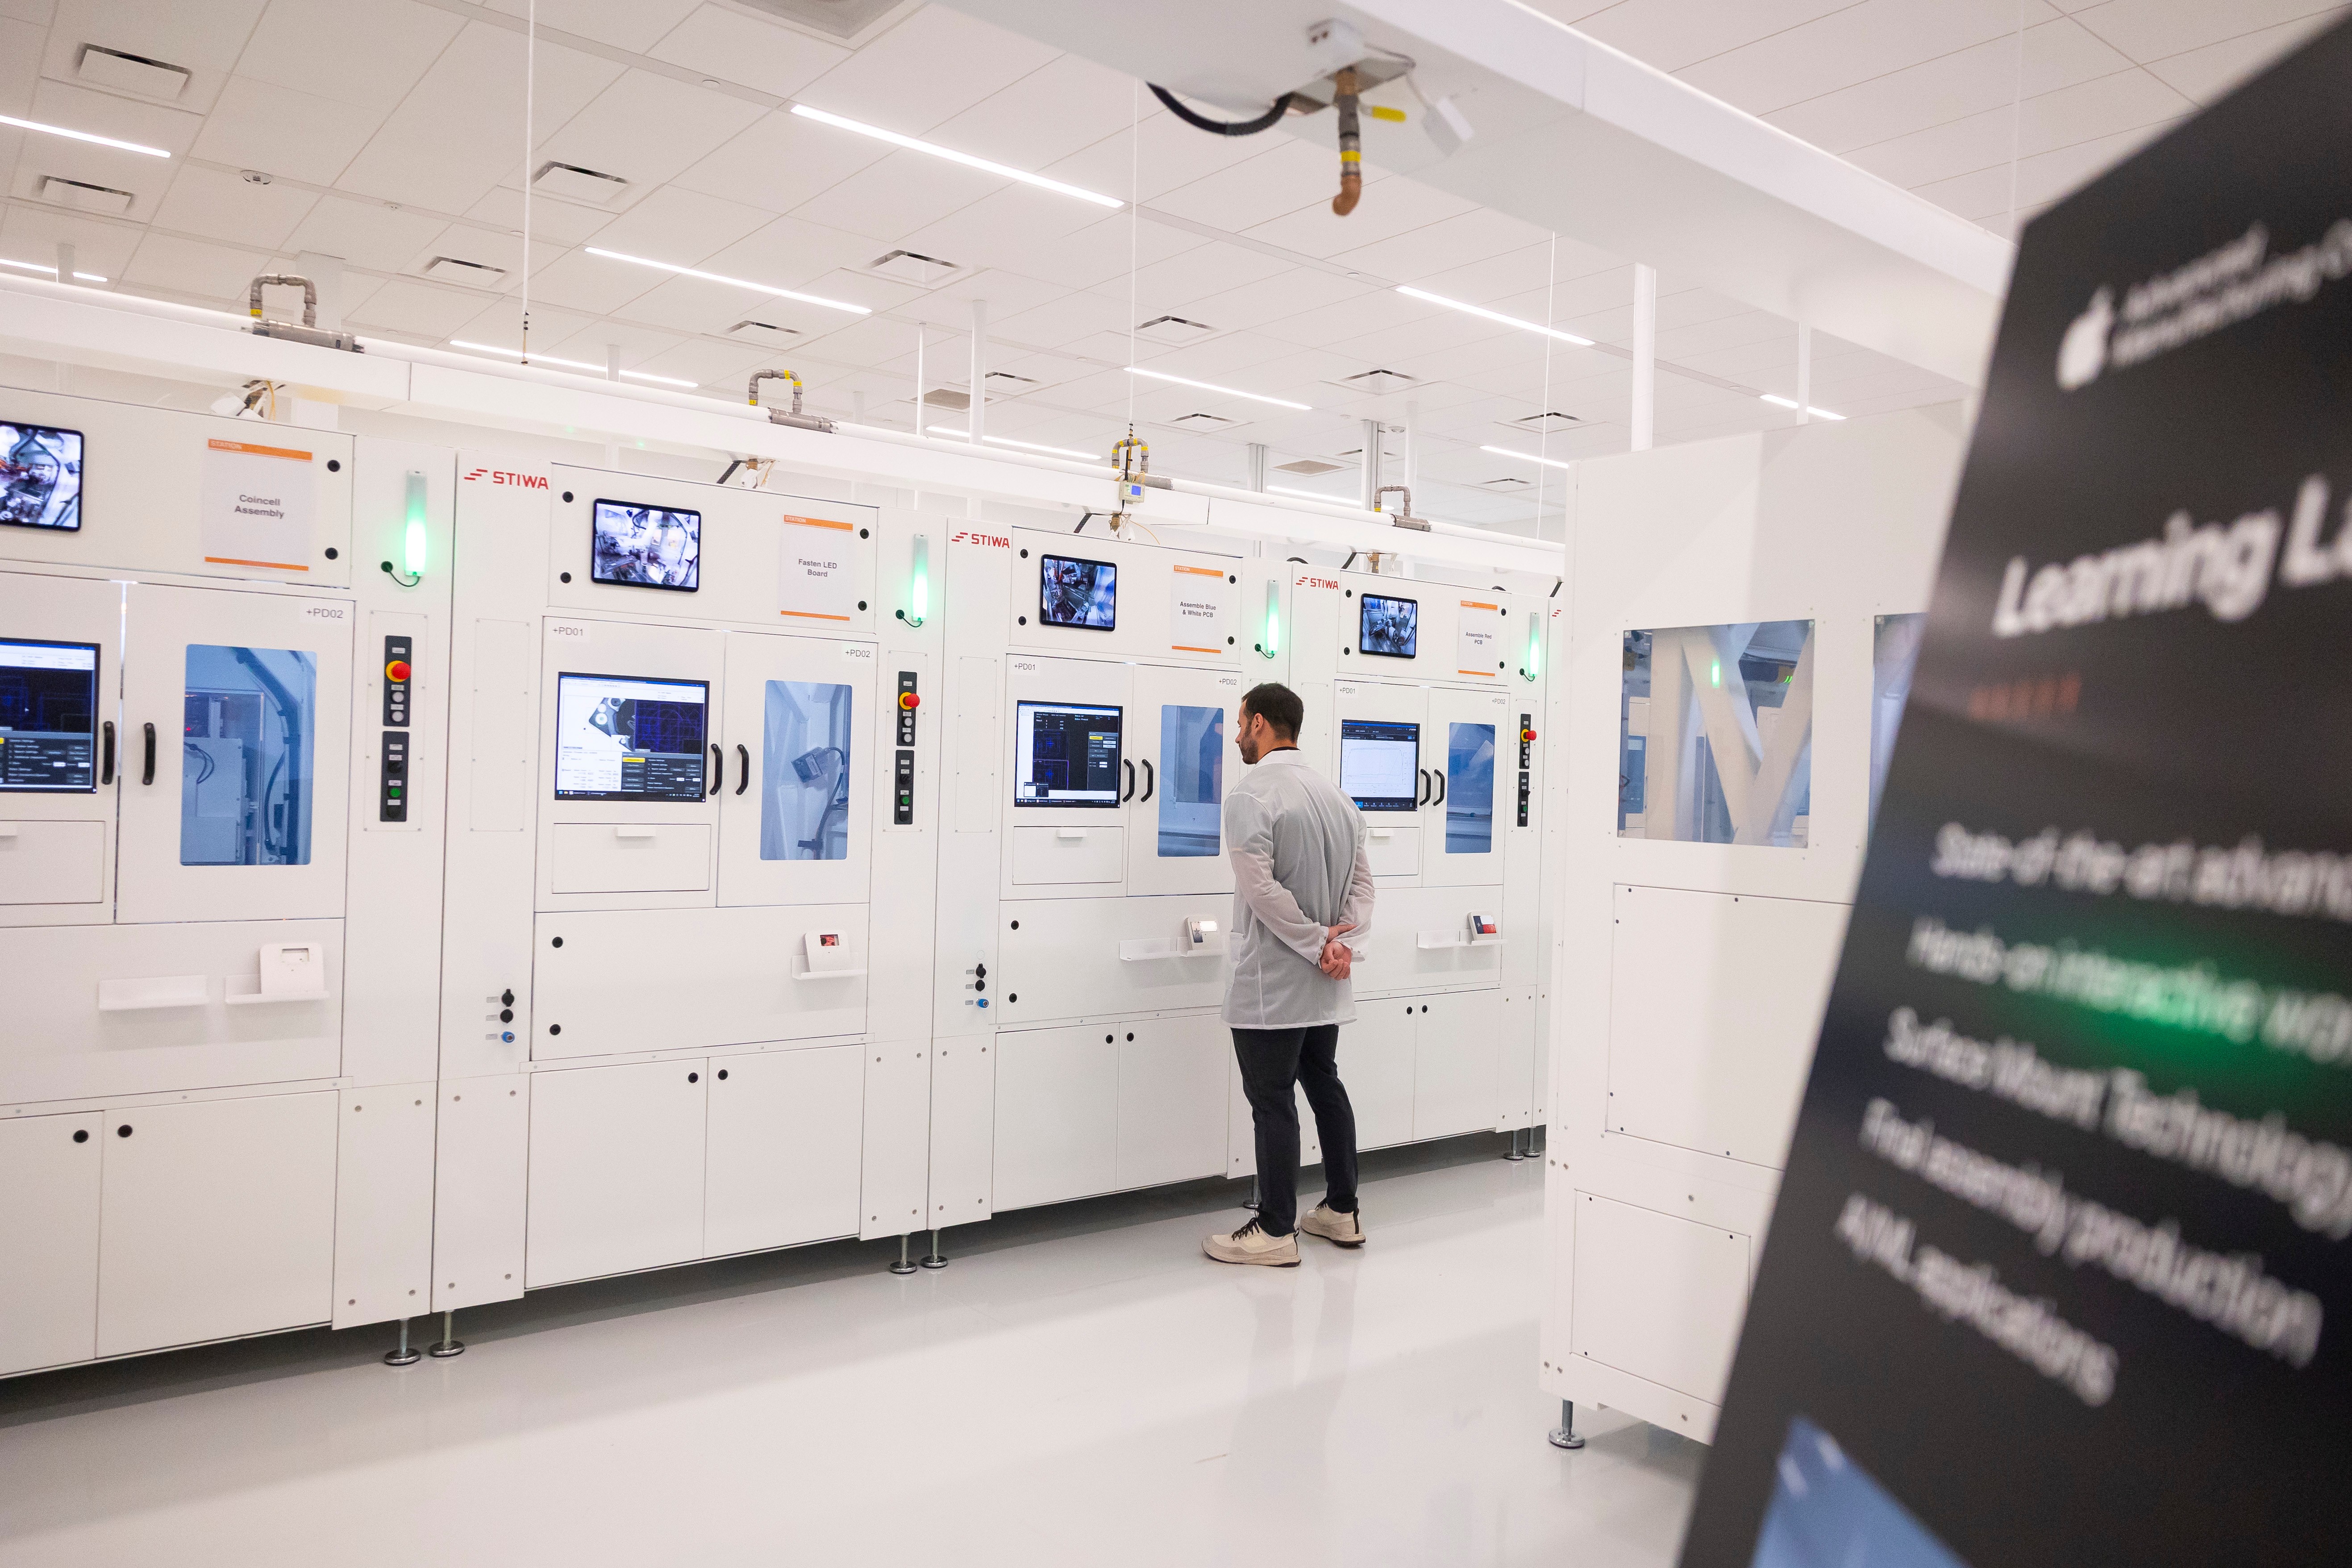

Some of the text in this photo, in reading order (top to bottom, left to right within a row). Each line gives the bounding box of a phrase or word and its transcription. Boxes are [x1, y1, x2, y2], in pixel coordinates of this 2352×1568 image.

[493, 471, 549, 490] STIWA
[239, 494, 280, 505] Coincell
[235, 505, 284, 519] Assembly
[971, 533, 1010, 549] STIWA
[798, 559, 837, 569] Fasten LED
[807, 569, 828, 577] Board
[1993, 509, 2282, 637] Learning
[1310, 578, 1338, 590] STIWA
[1179, 601, 1216, 611] Assemble Blue
[306, 608, 343, 619] +PD02
[553, 626, 583, 636] +PD01
[845, 649, 870, 658] +PD02
[1014, 663, 1036, 671] +PD01
[1885, 1007, 1990, 1088] Surface
[1992, 1037, 2107, 1131] Mount
[1859, 1097, 1934, 1172] Final
[2063, 1194, 2323, 1368] production
